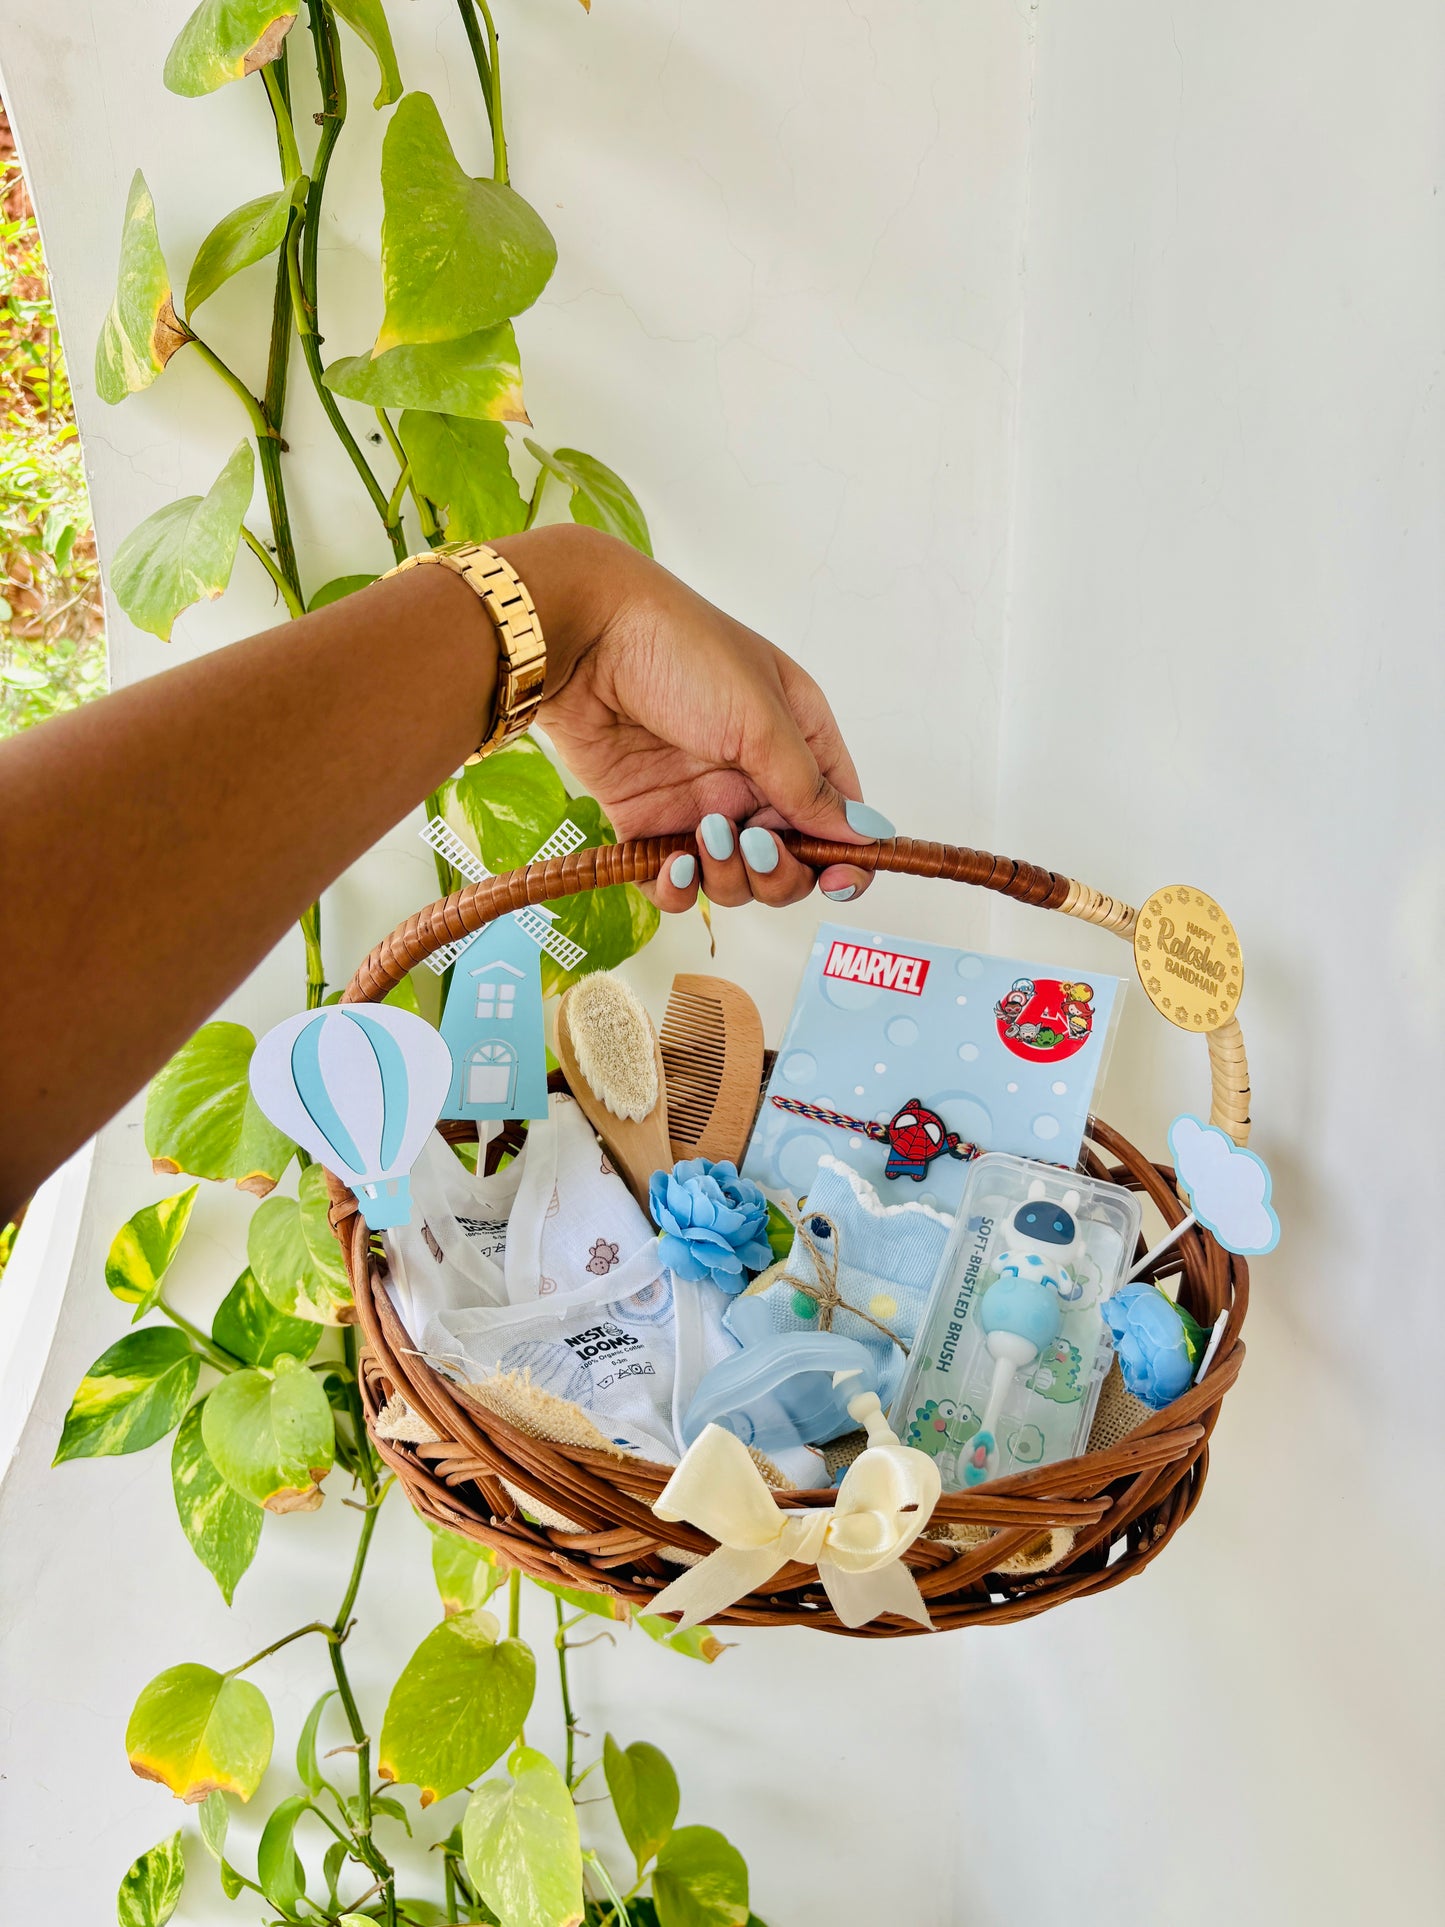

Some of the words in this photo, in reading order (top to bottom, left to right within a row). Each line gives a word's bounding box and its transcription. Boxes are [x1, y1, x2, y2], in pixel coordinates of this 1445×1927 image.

[1157, 917, 1227, 983] Raksha
[1186, 921, 1216, 945] HAPPY
[825, 943, 922, 994] MARVEL
[1164, 957, 1218, 998] BANDHAN
[462, 1223, 508, 1232] LOOM
[953, 1216, 994, 1320] SOFT-BRISTLED
[563, 1326, 607, 1348] NEST
[575, 1334, 639, 1361] LOOMS
[935, 1320, 964, 1373] BRUSH
[580, 1359, 599, 1371] 100%
[598, 1349, 624, 1361] Organic
[624, 1344, 645, 1353] Cotton
